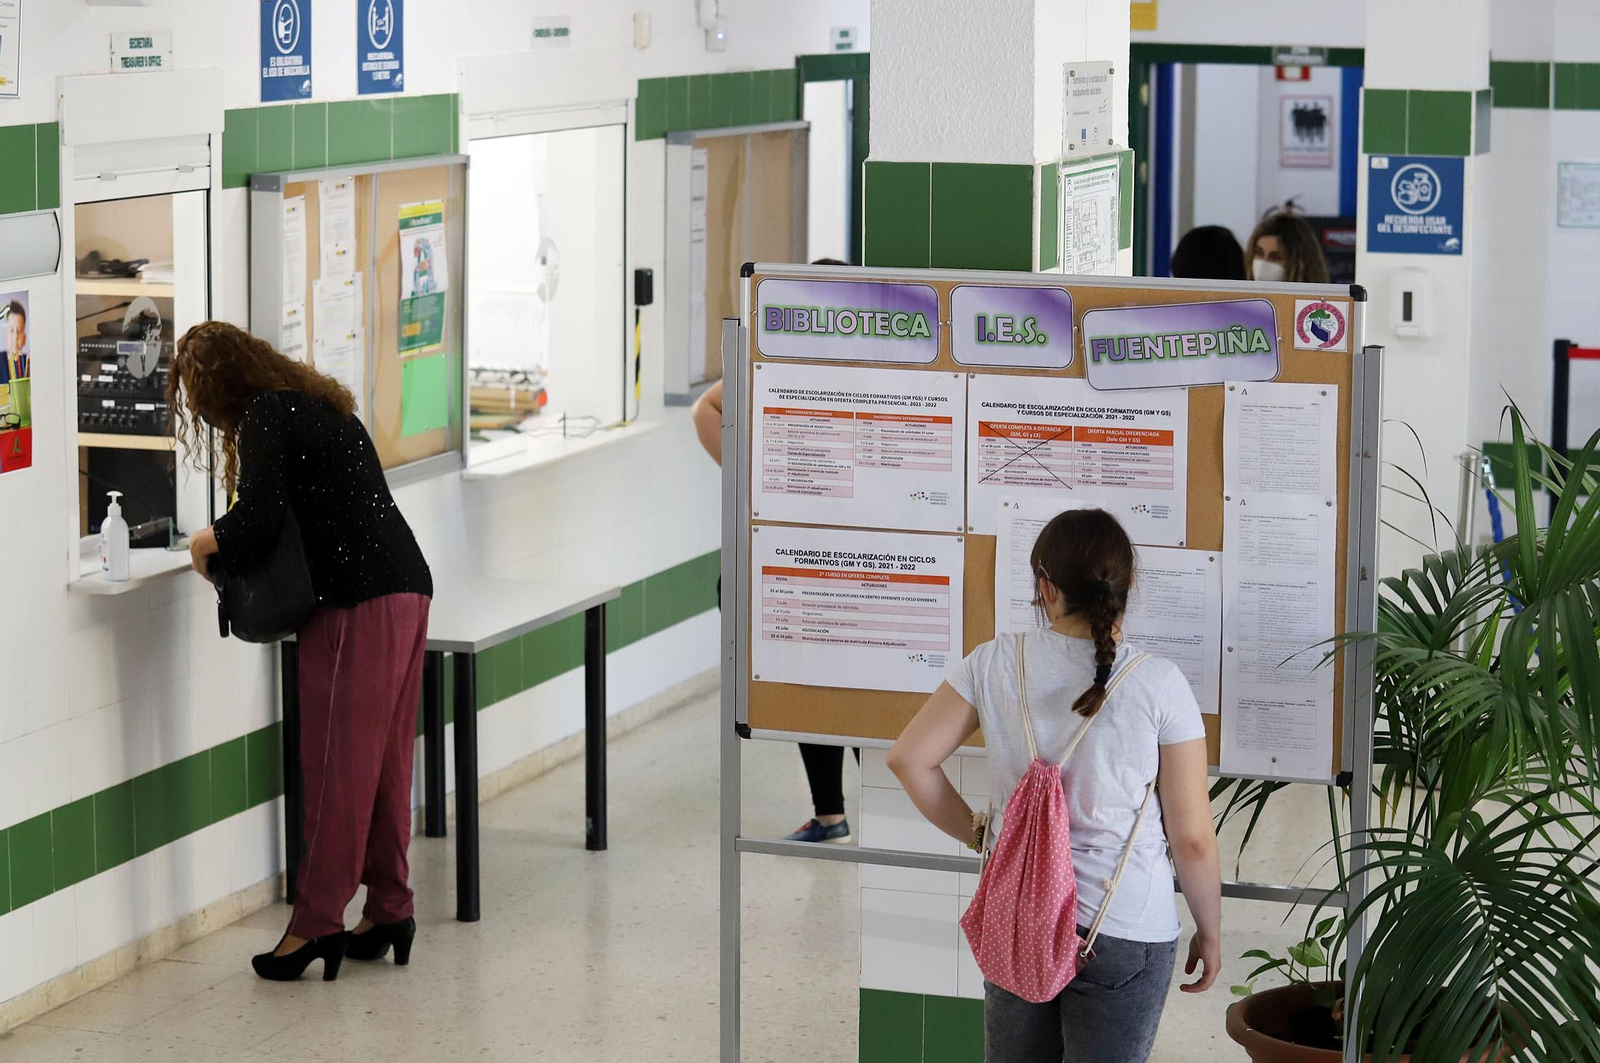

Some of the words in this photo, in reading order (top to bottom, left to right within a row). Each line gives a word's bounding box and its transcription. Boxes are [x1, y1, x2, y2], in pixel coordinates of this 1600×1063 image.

[270, 57, 276, 67] ES
[263, 68, 269, 78] EL
[278, 67, 284, 77] DE
[1384, 215, 1424, 224] RECUERDA
[1425, 216, 1446, 225] USAR
[1377, 223, 1392, 233] GEL
[1392, 224, 1452, 235] DESINFECTANTE
[764, 307, 931, 338] BIBLIOTECA
[977, 316, 1047, 343] I.E.S.
[1091, 325, 1272, 362] FUENTEPIÑA
[775, 548, 821, 558] CALENDARIO
[833, 551, 896, 562] ESCOLARIZACIÓN
[794, 557, 840, 566] FORMATIVOS
